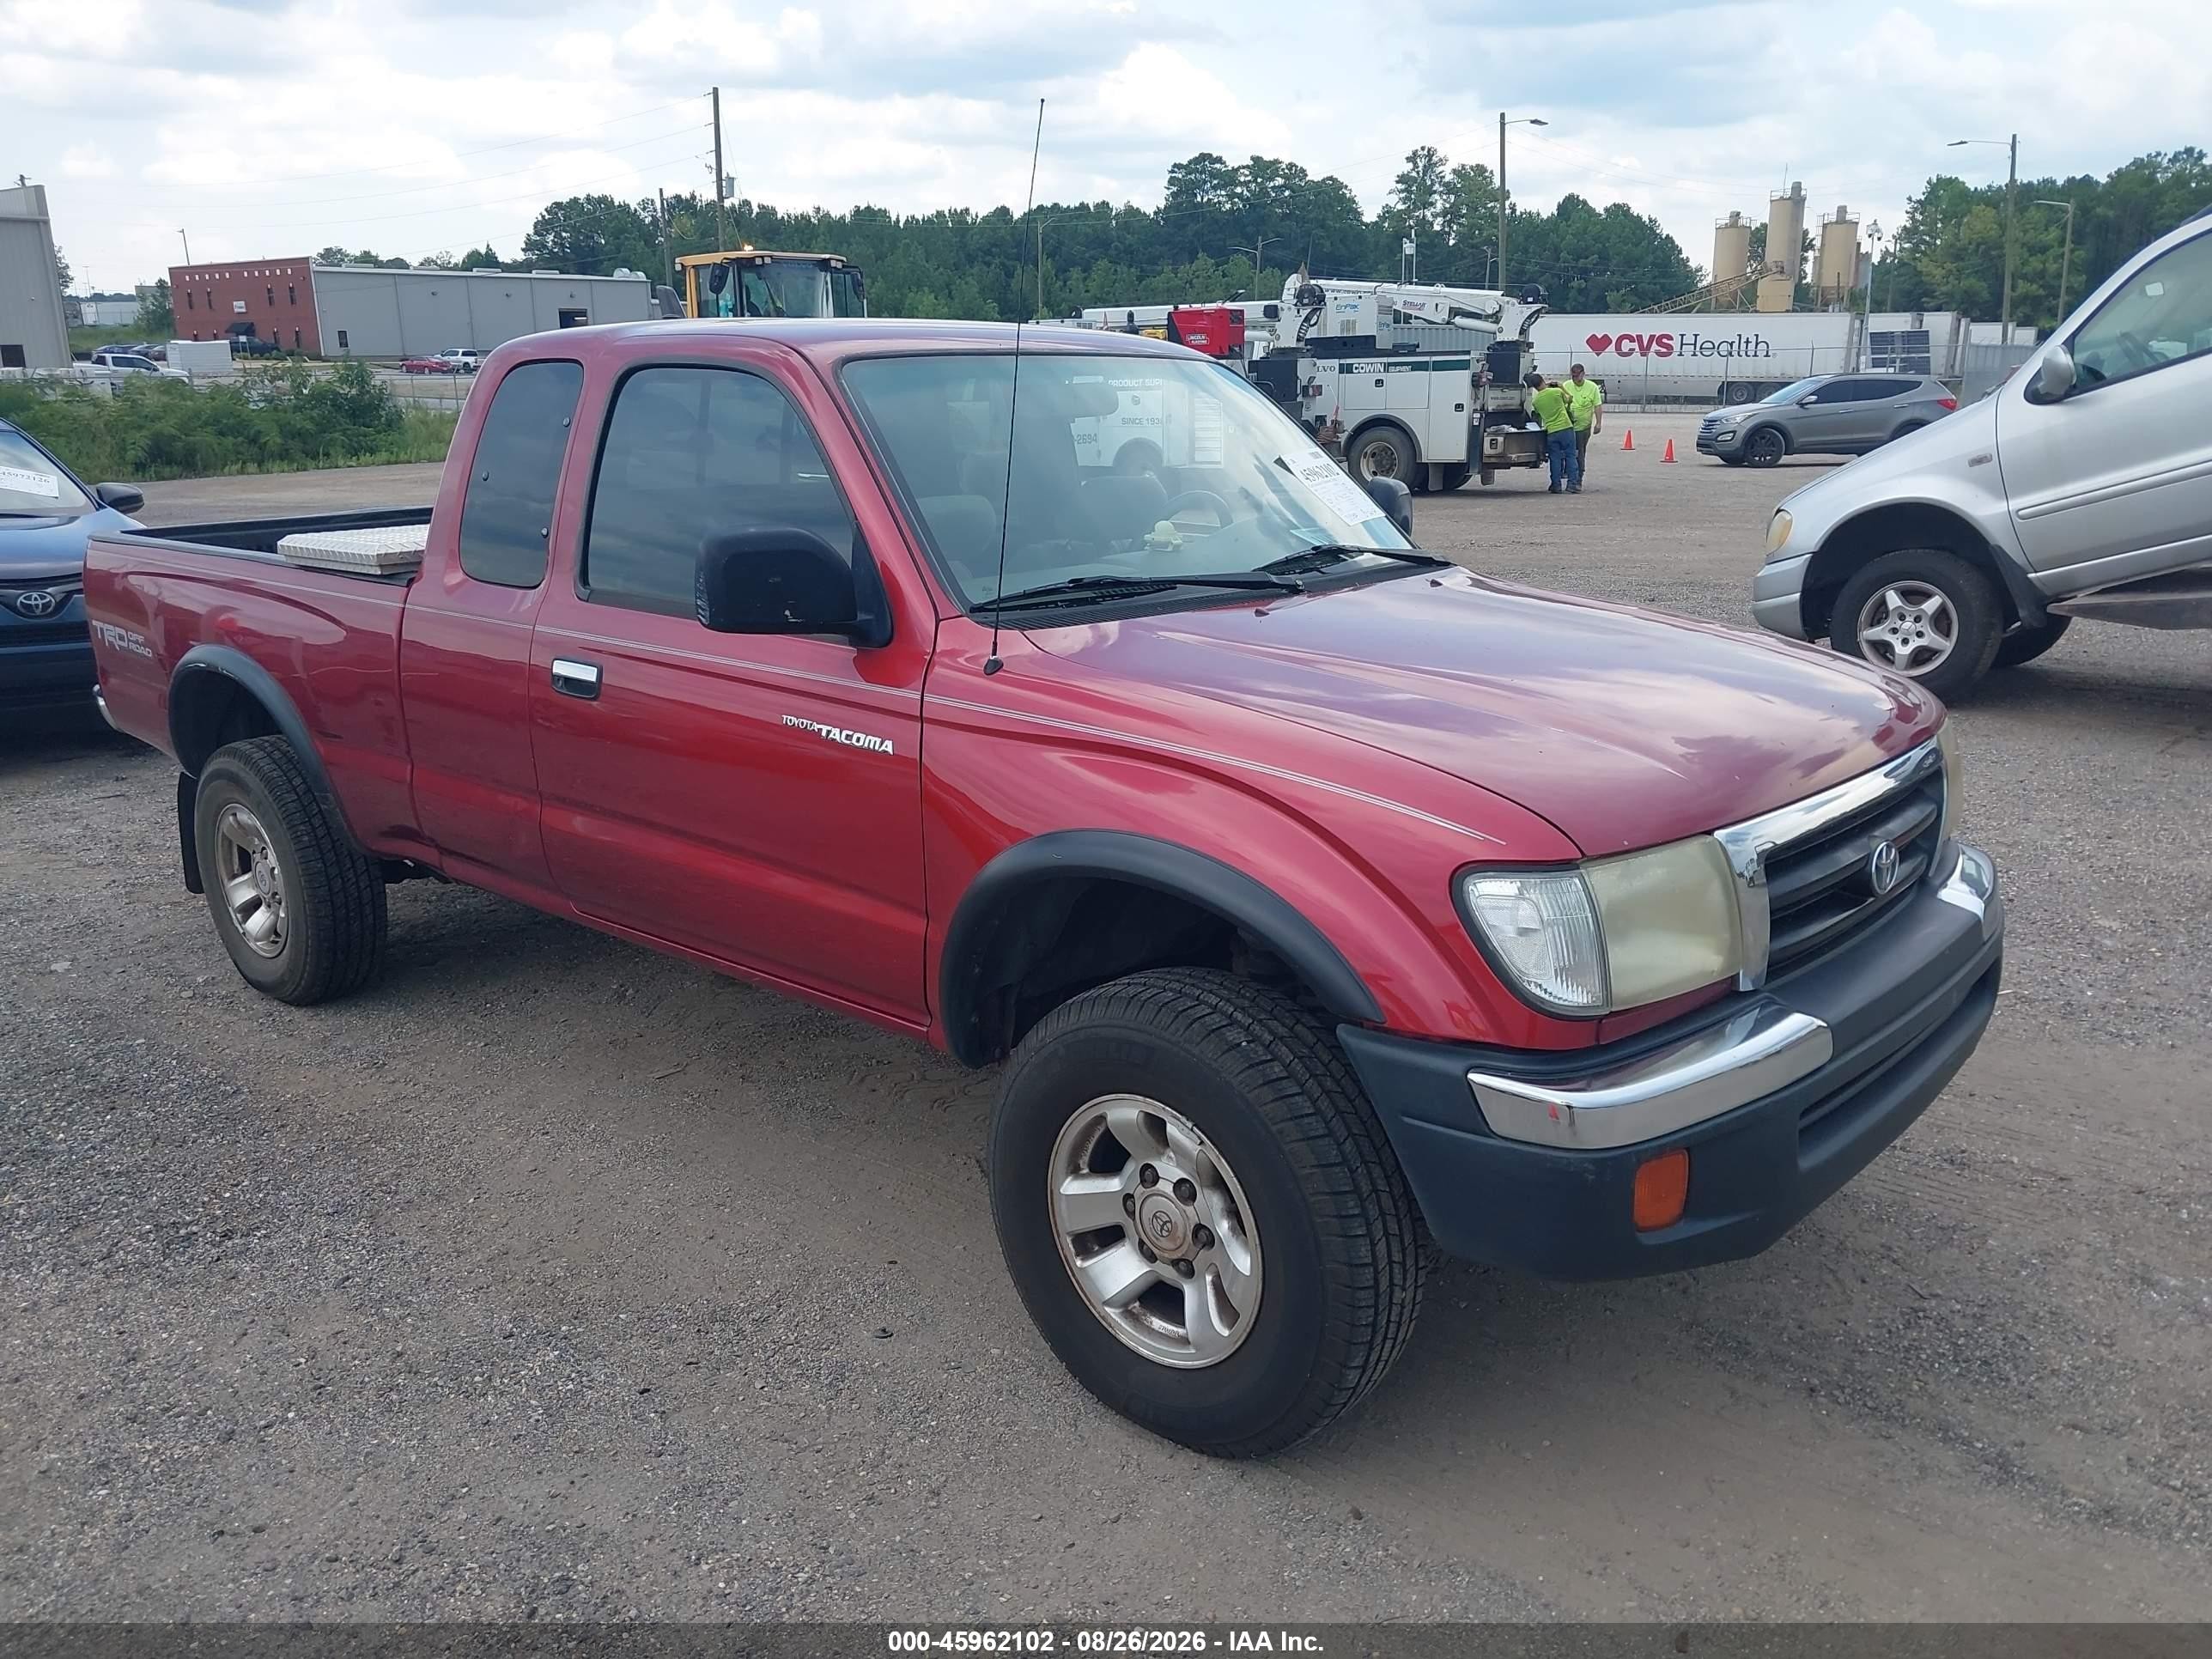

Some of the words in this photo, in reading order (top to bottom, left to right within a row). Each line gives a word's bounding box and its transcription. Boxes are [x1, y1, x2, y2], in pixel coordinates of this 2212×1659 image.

[1614, 333, 1674, 358] CVS
[1677, 333, 1771, 358] Health
[1352, 362, 1384, 373] COWIN
[1108, 379, 1143, 387] PRODUCT
[1121, 417, 1144, 426] SINCE
[1299, 464, 1340, 483] 45962102
[92, 619, 128, 651] TRD
[128, 631, 144, 644] OFF
[129, 641, 152, 658] ROAD
[781, 714, 817, 732] TOYOTA
[817, 724, 894, 755] TACOMA
